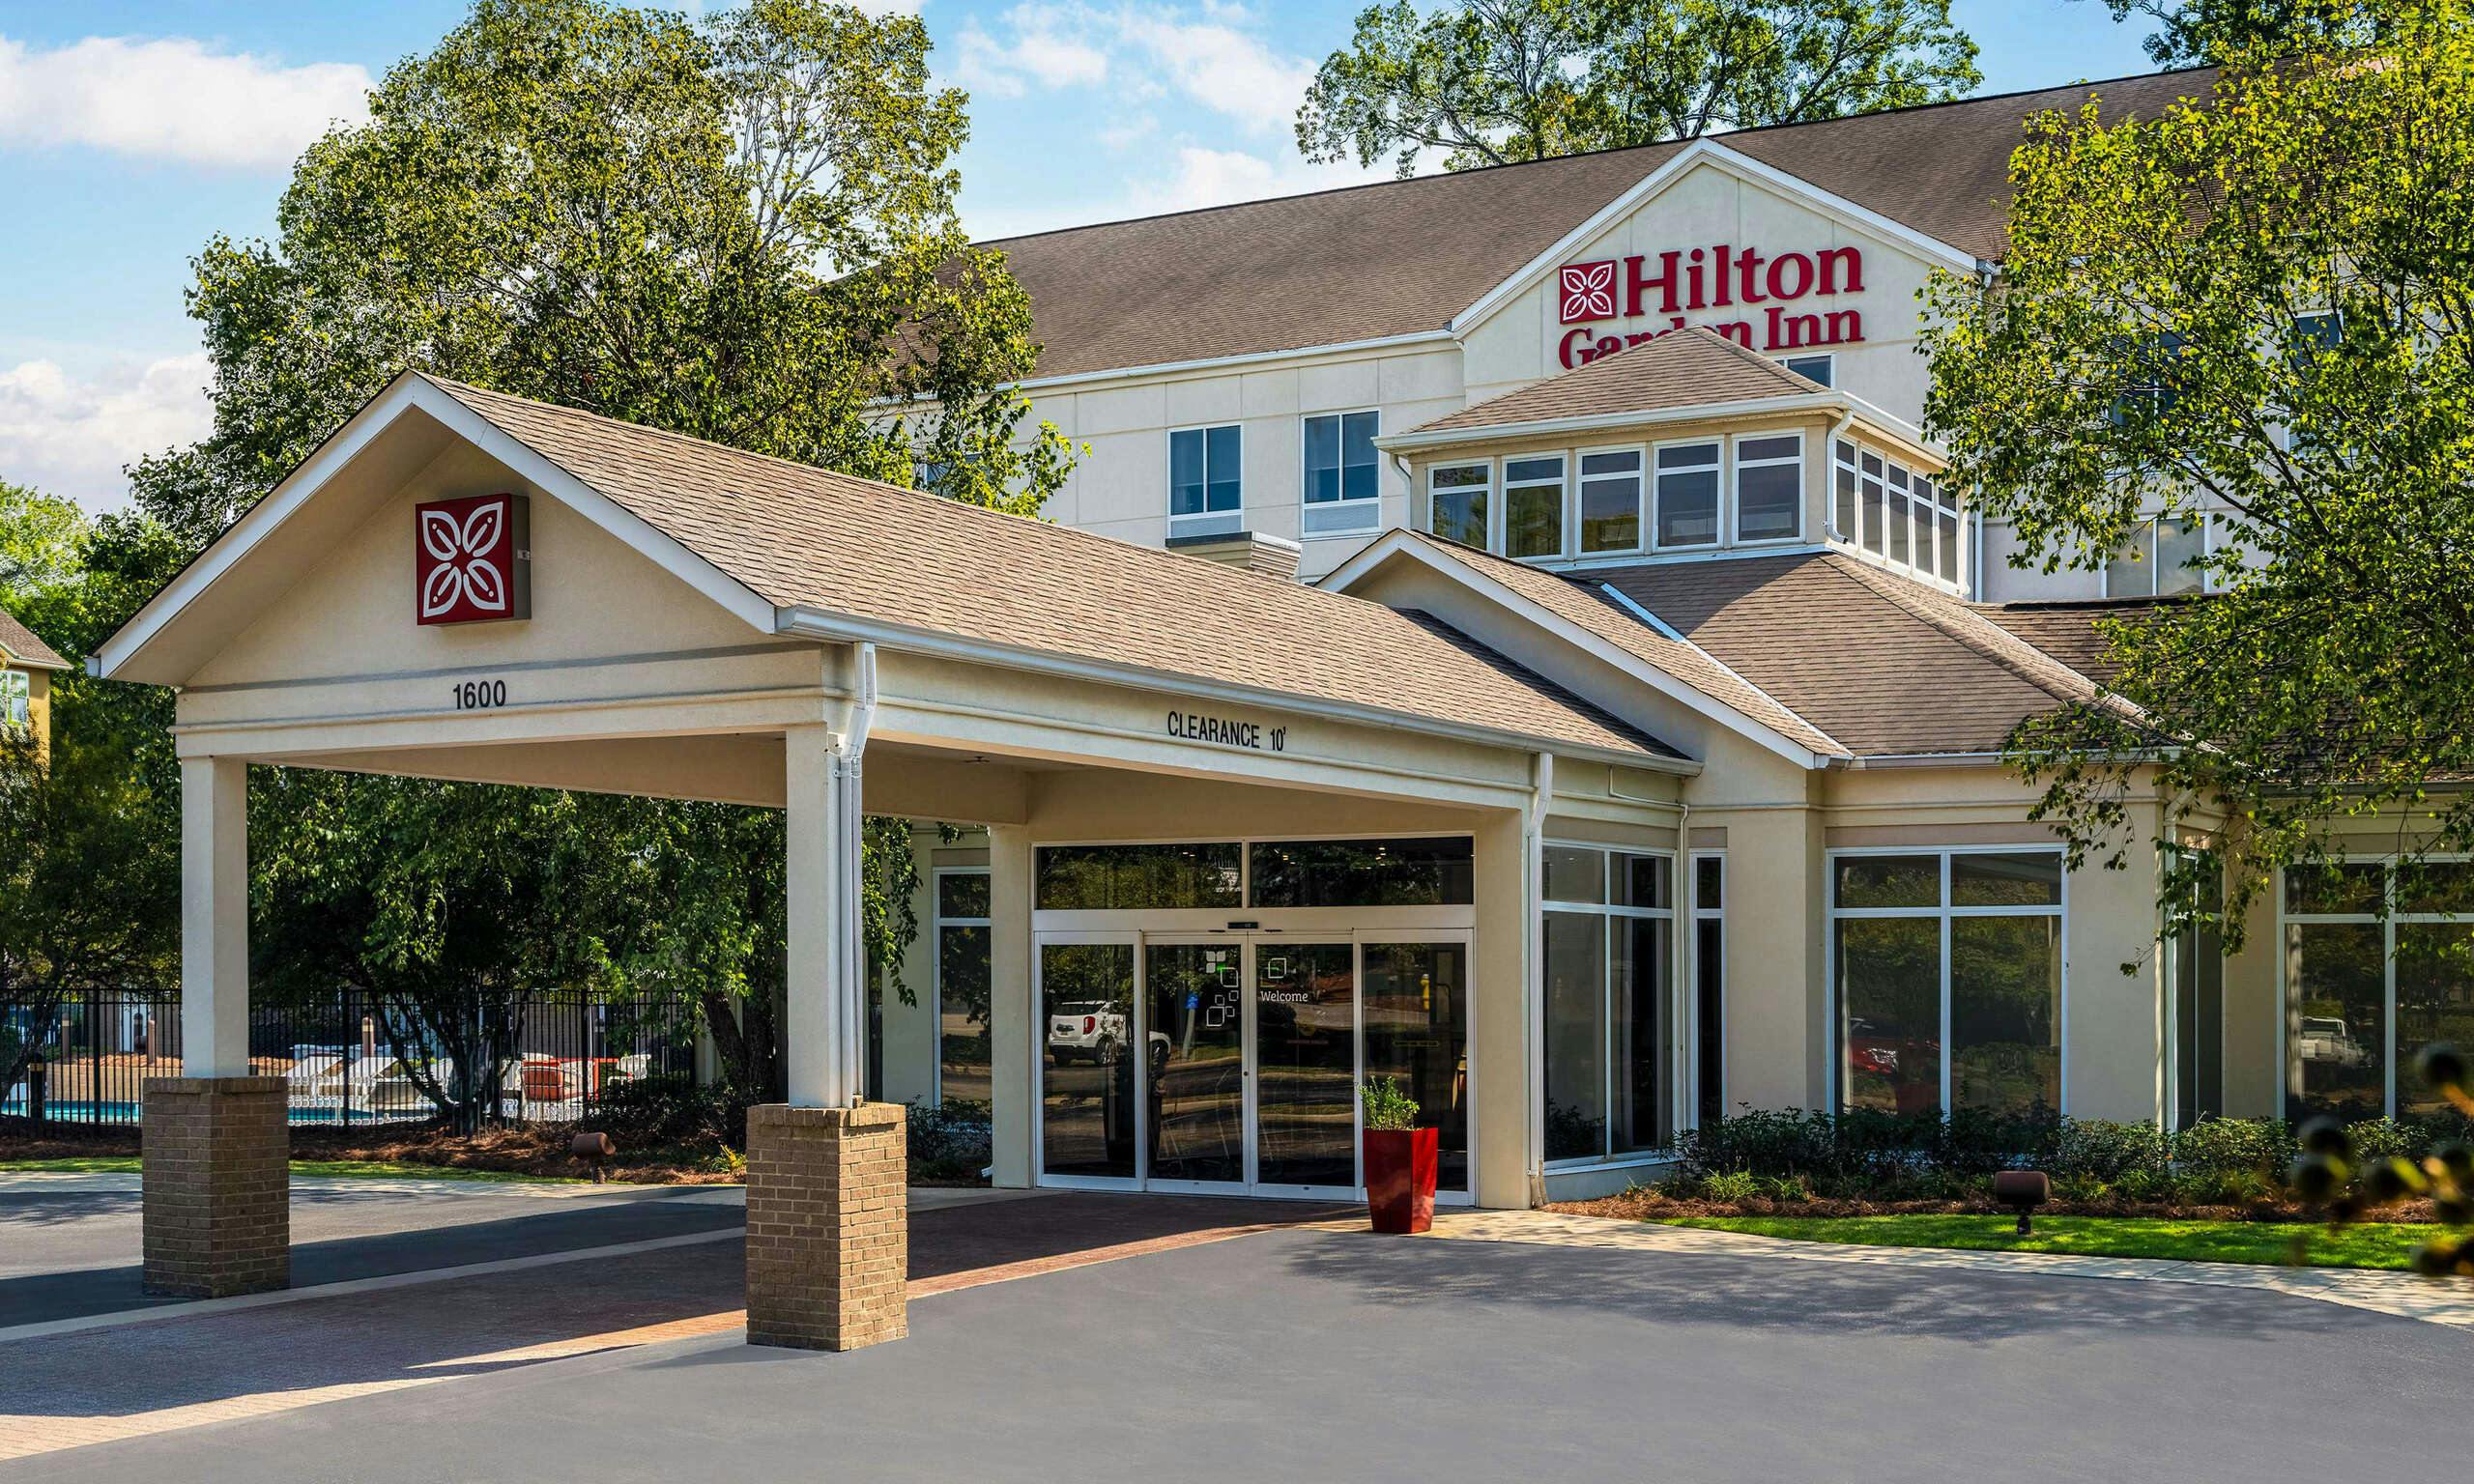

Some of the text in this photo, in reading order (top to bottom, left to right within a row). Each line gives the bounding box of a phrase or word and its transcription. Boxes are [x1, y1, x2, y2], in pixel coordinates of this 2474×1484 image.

[1624, 244, 1865, 317] Hilton
[1763, 306, 1866, 352] Inn
[452, 679, 506, 710] 1600
[1167, 710, 1260, 749] CLEARANCE
[1260, 990, 1309, 1002] Welcome
